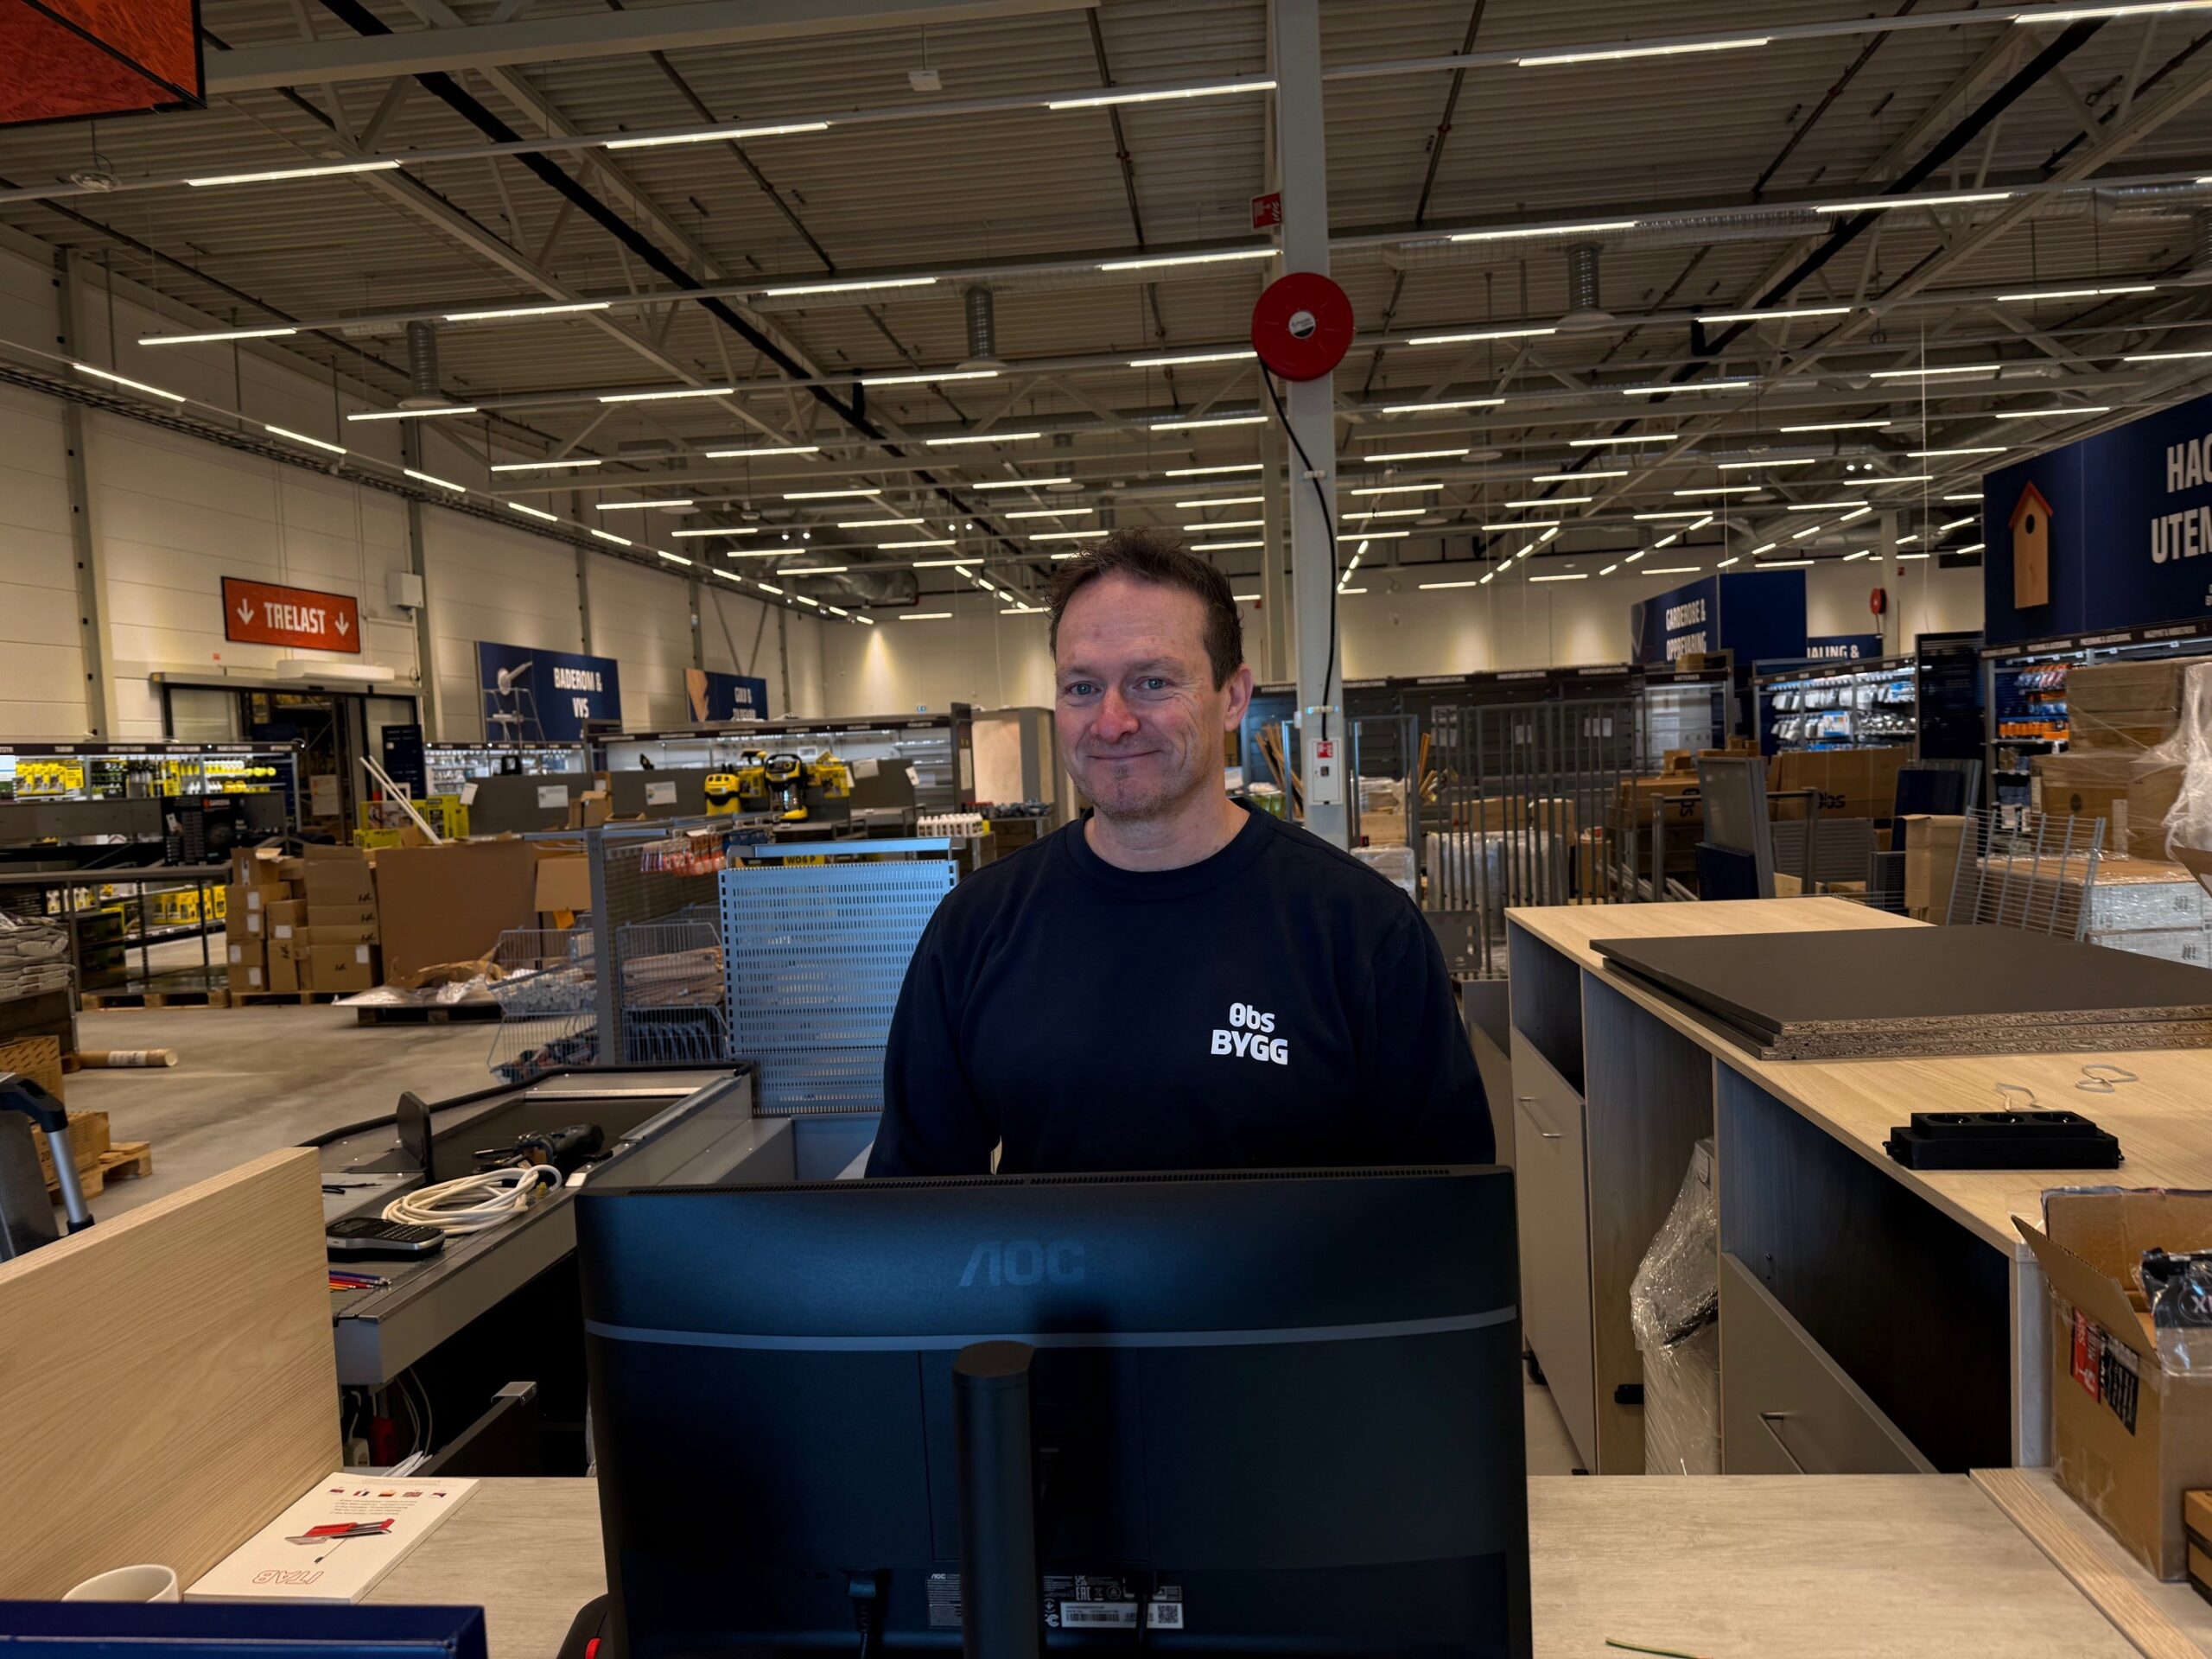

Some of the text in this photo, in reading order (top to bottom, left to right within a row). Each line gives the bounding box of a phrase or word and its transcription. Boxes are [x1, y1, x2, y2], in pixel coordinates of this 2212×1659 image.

[264, 601, 326, 635] TRELAST
[1666, 598, 1707, 632] GARDEROBE &
[1850, 645, 1860, 659] &
[553, 666, 603, 692] BADEROM &
[572, 696, 590, 719] VVS
[1230, 1001, 1275, 1033] Obs
[1211, 1029, 1288, 1065] BYGG
[959, 1239, 1085, 1287] AOC
[252, 1569, 325, 1586] ITAB
